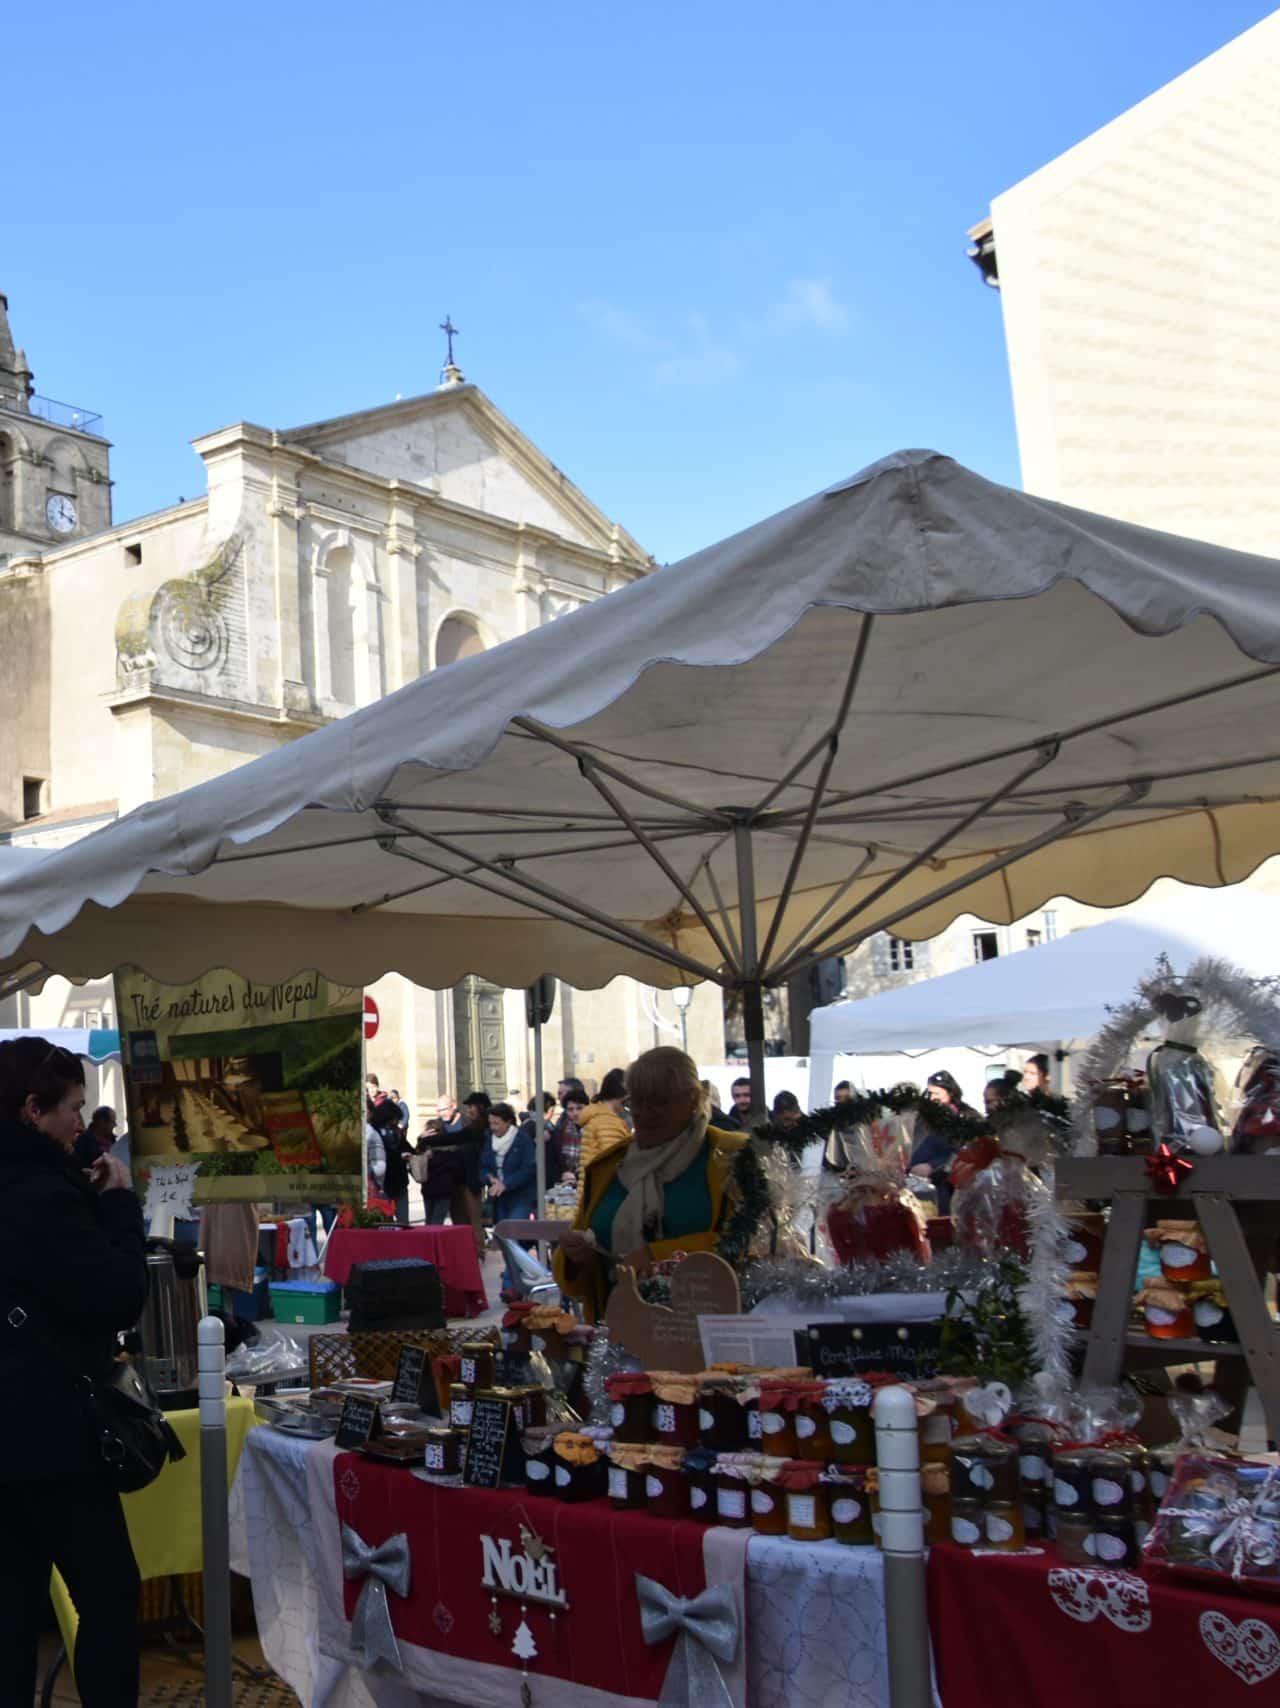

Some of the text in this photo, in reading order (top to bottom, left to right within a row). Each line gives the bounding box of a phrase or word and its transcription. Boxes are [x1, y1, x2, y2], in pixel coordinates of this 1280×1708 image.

[130, 992, 161, 1027] Thé
[168, 984, 235, 1018] naturel
[242, 979, 267, 1009] du
